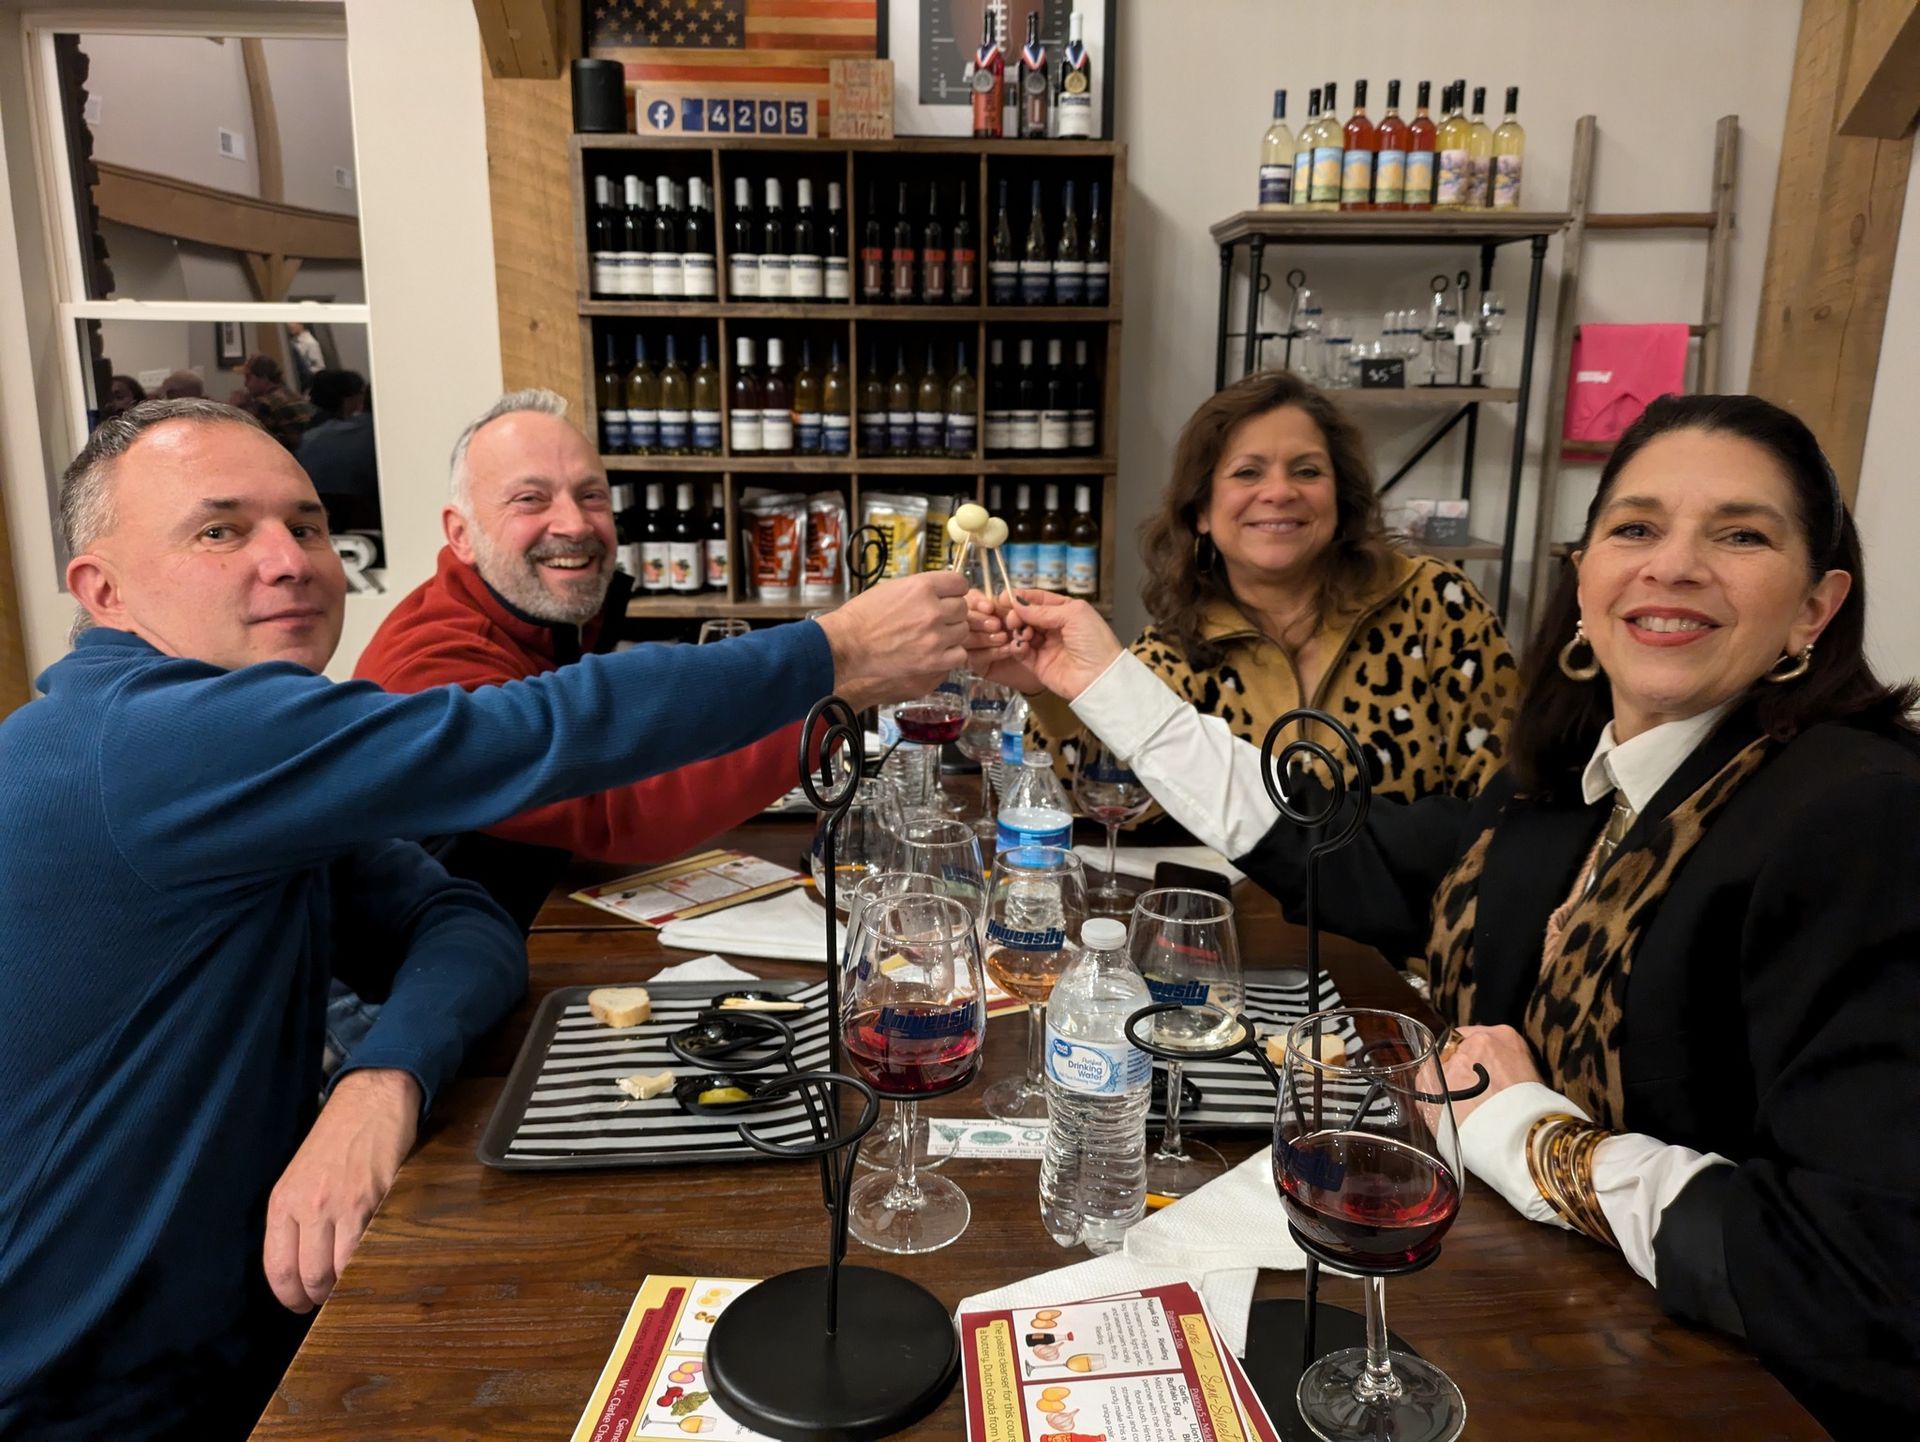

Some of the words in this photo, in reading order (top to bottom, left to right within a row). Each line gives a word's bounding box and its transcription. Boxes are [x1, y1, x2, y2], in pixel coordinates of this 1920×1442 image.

[1067, 1060, 1103, 1076] Drinking
[1077, 1069, 1103, 1081] Water
[994, 1322, 1004, 1334] The
[1151, 1316, 1160, 1327] Egg
[1158, 1338, 1169, 1360] Riesling
[1182, 1316, 1201, 1344] Course
[1193, 1349, 1214, 1360] 2
[996, 1335, 1006, 1357] palate
[984, 1364, 993, 1387] Dutch
[999, 1358, 1009, 1390] cleanser
[614, 1379, 629, 1396] W.C.
[1003, 1390, 1012, 1401] for
[1110, 1386, 1119, 1404] candy
[1134, 1390, 1142, 1404] floral
[1142, 1379, 1152, 1403] partner
[1166, 1378, 1177, 1401] Buffalo
[1173, 1402, 1182, 1415] Egg
[1178, 1385, 1190, 1405] Garlic
[985, 1388, 996, 1415] Gouda
[1149, 1402, 1157, 1415] with
[1157, 1391, 1166, 1406] heat
[1190, 1388, 1203, 1412] Pairing
[603, 1397, 621, 1423] Clarke
[1004, 1403, 1014, 1419] this
[1102, 1404, 1111, 1425] unique
[1114, 1405, 1122, 1422] make
[1121, 1386, 1133, 1419] strawberry
[1130, 1420, 1138, 1432] and
[1161, 1405, 1171, 1427] buffalo
[989, 1416, 999, 1437] from
[1118, 1423, 1126, 1435] this
[1152, 1417, 1160, 1427] the
[1167, 1429, 1176, 1440] and
